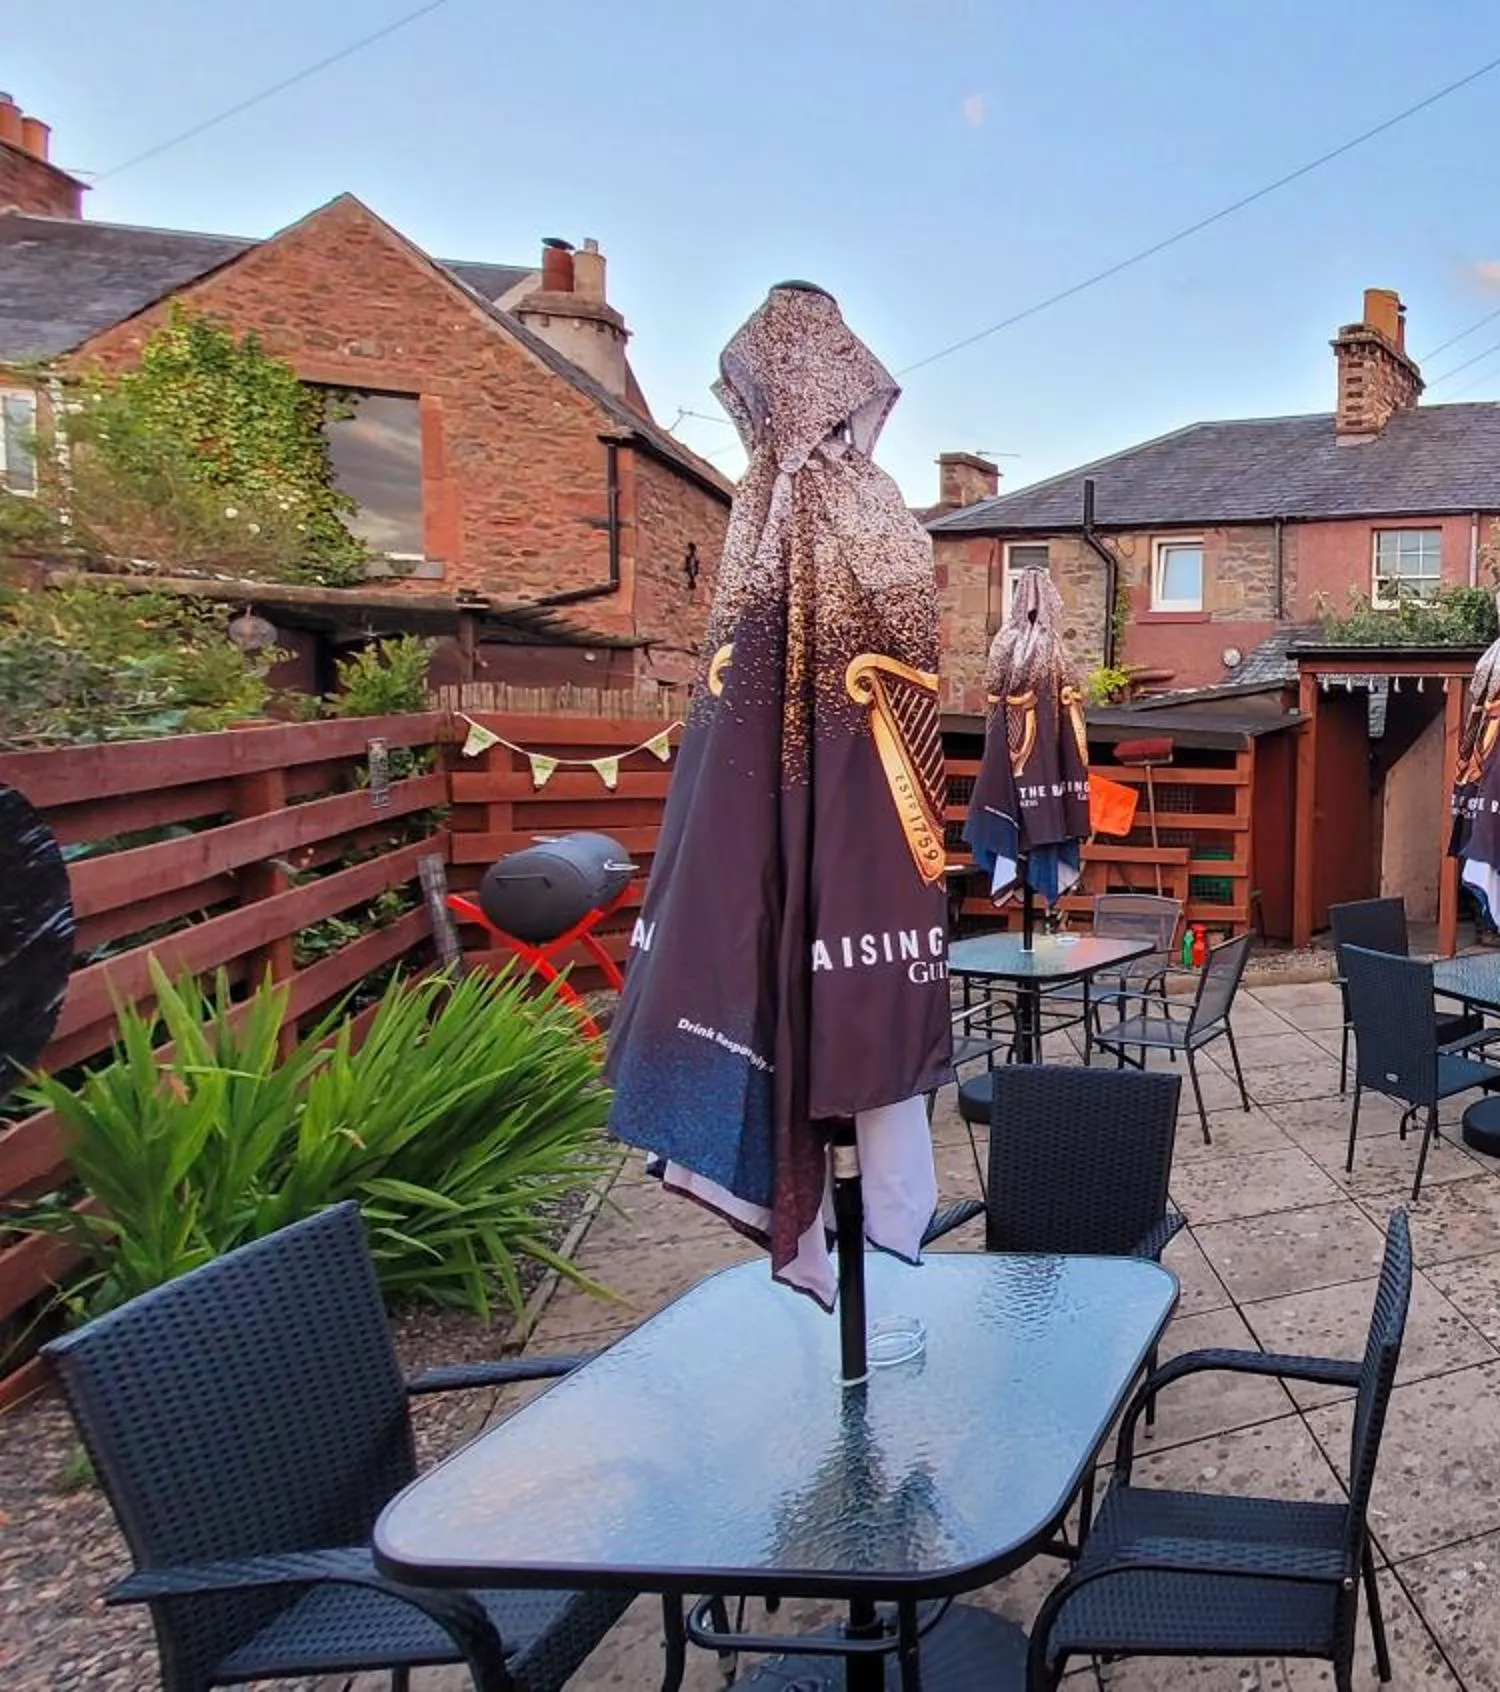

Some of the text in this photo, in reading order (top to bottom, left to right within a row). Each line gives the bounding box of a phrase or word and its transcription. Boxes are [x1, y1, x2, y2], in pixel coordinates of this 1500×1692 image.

[1019, 785, 1047, 799] THE
[909, 816, 940, 861] 1759
[811, 926, 944, 972] AISING
[677, 1017, 715, 1040] Drink
